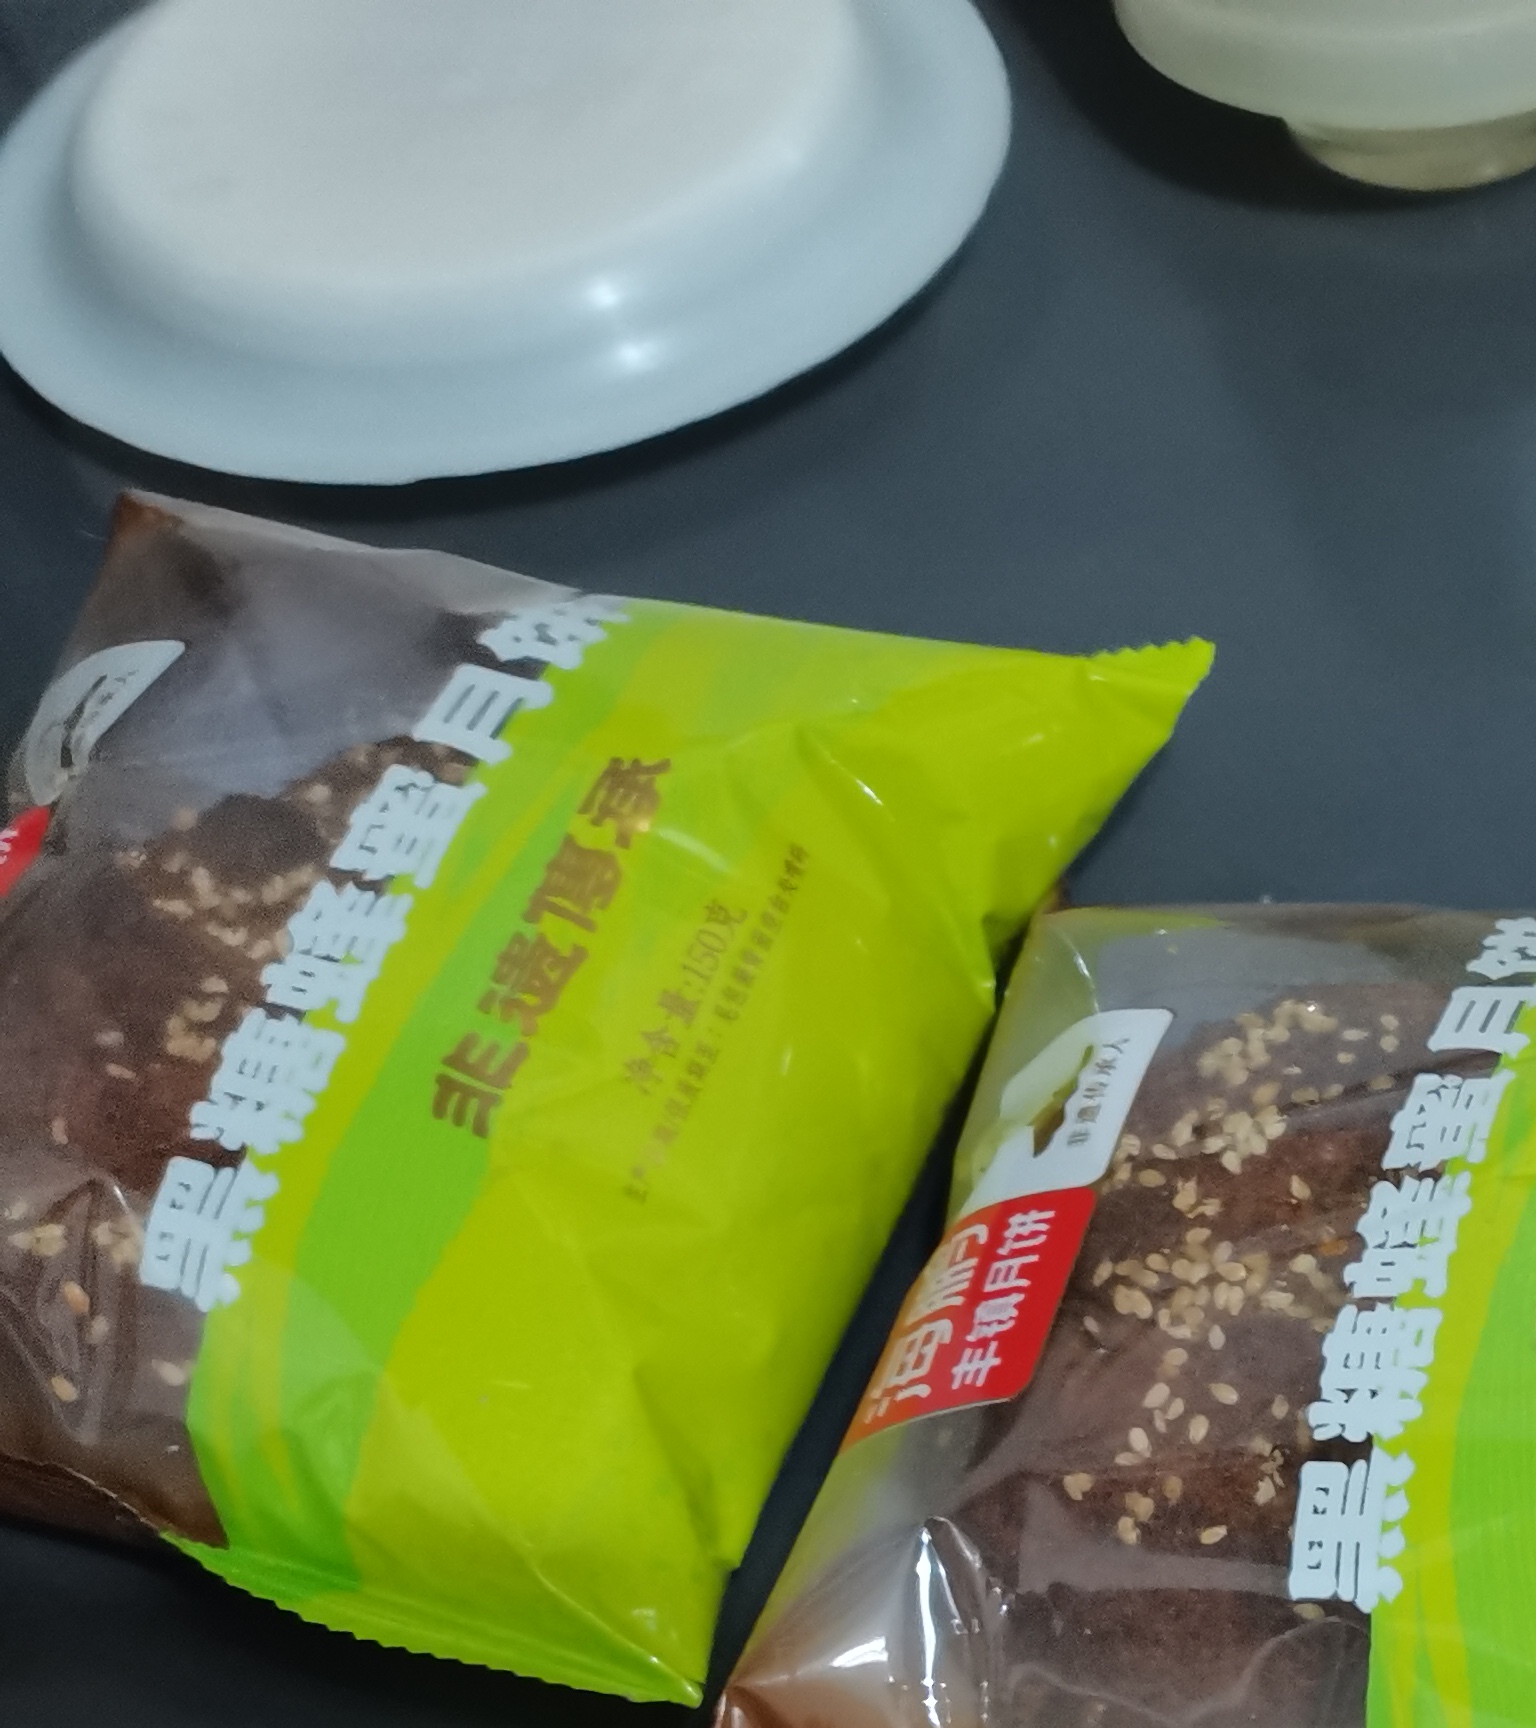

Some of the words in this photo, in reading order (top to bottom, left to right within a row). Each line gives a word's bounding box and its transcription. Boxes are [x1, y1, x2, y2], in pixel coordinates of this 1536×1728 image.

[140, 592, 634, 1313] 黑糖蜂蜜月饼
[951, 1208, 1057, 1390] 丰镇月饼
